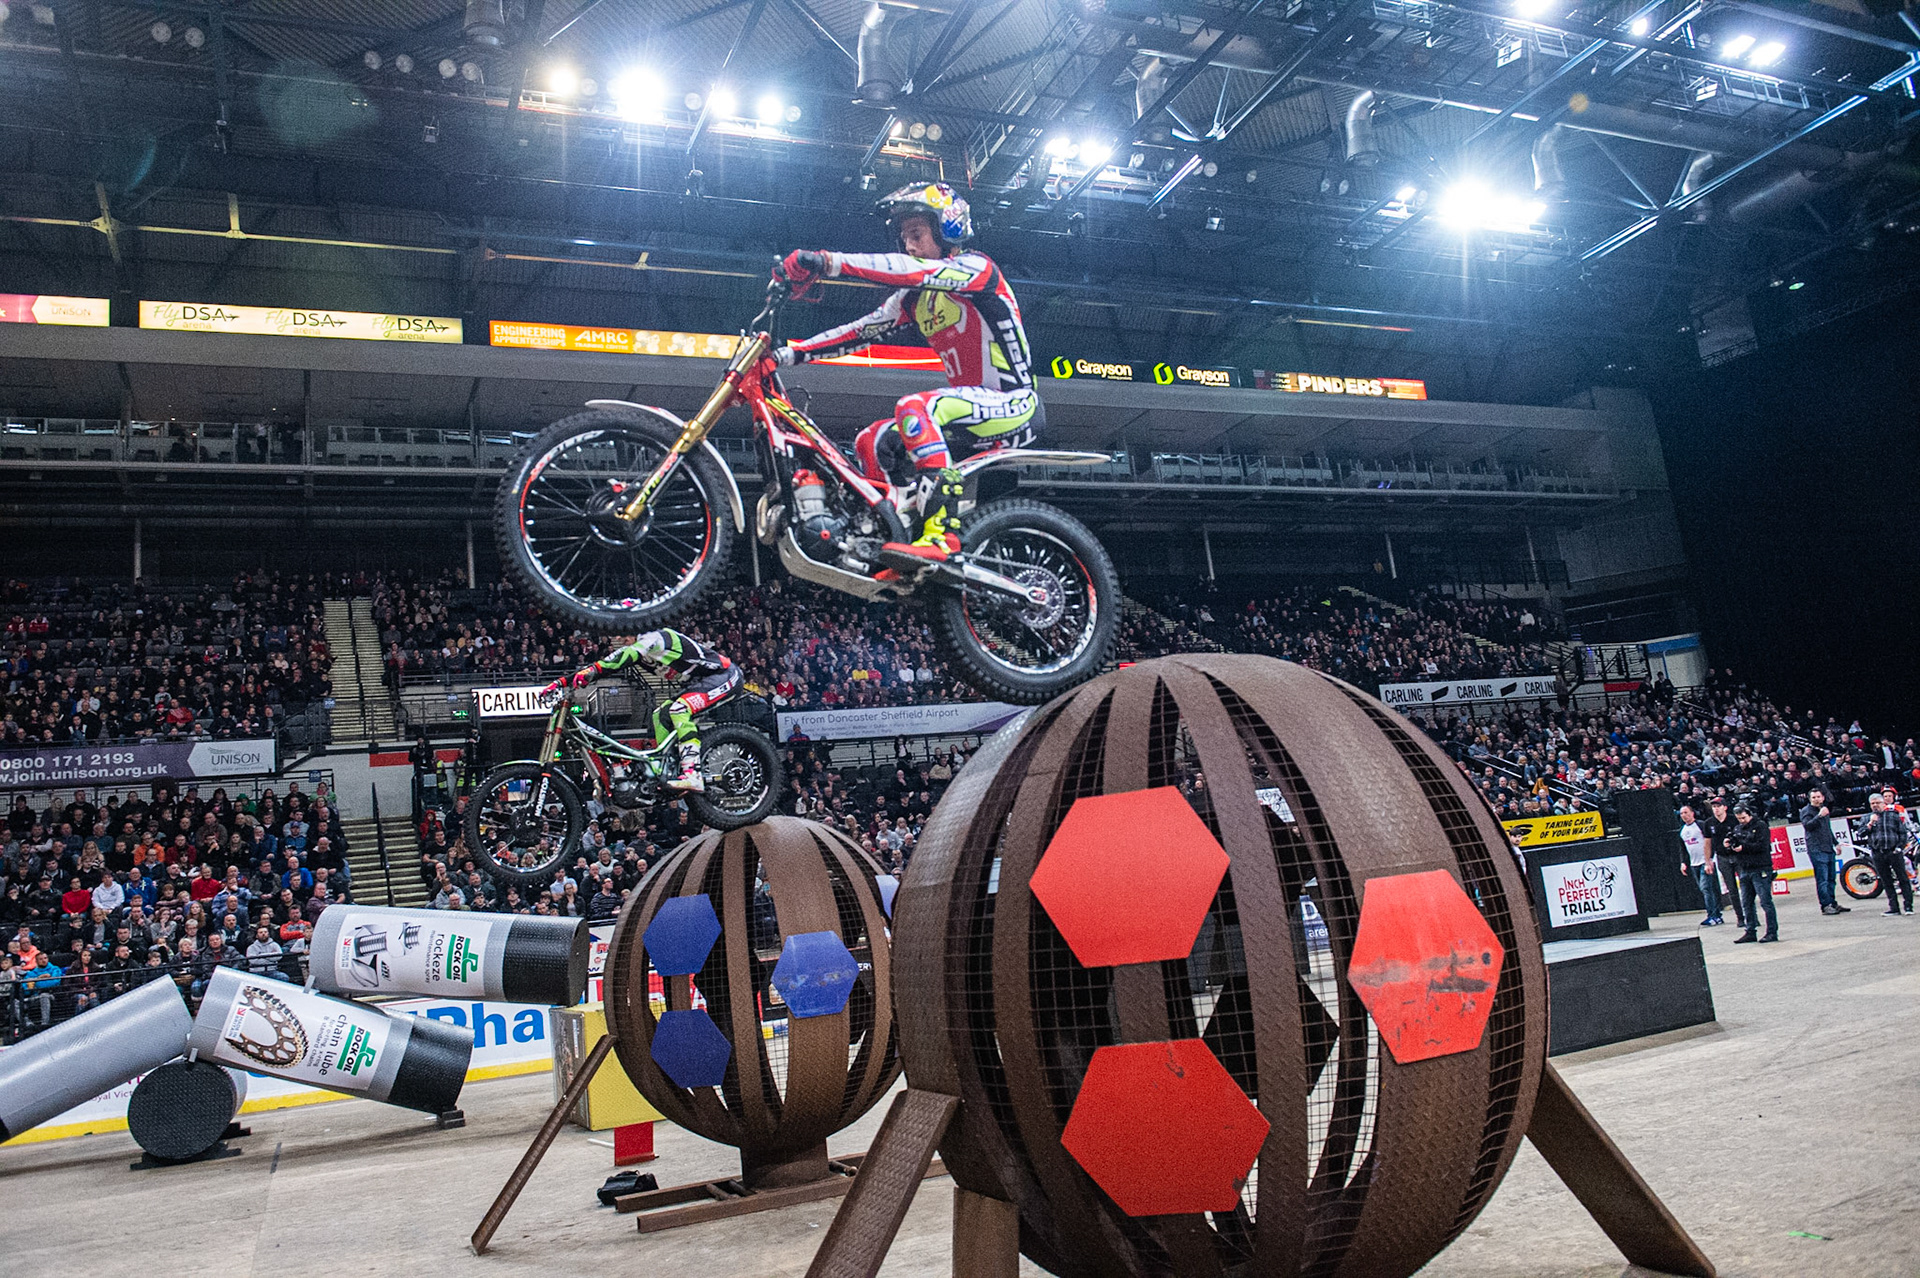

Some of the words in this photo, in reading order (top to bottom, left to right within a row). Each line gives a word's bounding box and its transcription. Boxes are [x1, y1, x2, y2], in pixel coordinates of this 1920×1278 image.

[51, 307, 91, 317] UNISON
[153, 304, 183, 326] Fly
[182, 305, 228, 321] DSA
[182, 320, 213, 329] arena
[264, 310, 294, 332] Fly
[293, 312, 335, 327] DSA
[372, 315, 399, 338] Fly
[397, 317, 439, 332] DSA
[293, 327, 321, 335] arena
[398, 332, 426, 341] arena
[493, 325, 566, 339] ENGINEERING
[574, 330, 629, 345] AMRC
[493, 335, 567, 347] APPRENTICESHIPS
[997, 318, 1033, 389] heb
[1075, 358, 1133, 378] Grayson
[1176, 365, 1230, 385] Grayson
[1297, 374, 1384, 396] PINDERS
[972, 398, 1032, 420] hebo
[1384, 688, 1424, 703] CARLING
[1456, 684, 1494, 699] CARLING
[1524, 681, 1556, 695] CARLIN
[784, 716, 800, 727] Fly
[801, 715, 826, 725] from
[828, 713, 878, 724] Doncaster
[881, 709, 923, 721] Sheffield
[926, 708, 959, 719] Airport
[0, 756, 45, 770] 0800
[52, 754, 83, 767] 171
[90, 752, 135, 765] 2193
[211, 753, 261, 766] UNISON
[534, 777, 549, 817] NONSTOP
[1539, 831, 1549, 839] OF
[1551, 828, 1571, 838] YOUR
[1571, 824, 1598, 835] WASTE
[1545, 819, 1573, 830] TAKING
[1573, 816, 1594, 826] CARE
[1563, 876, 1586, 890] INCH
[1558, 887, 1600, 904] PERFECT
[1561, 899, 1606, 917] TRIALS
[432, 933, 446, 982] rockeze
[452, 935, 465, 965] ROCK
[452, 965, 462, 981] OIL
[329, 1014, 347, 1048] chain
[427, 1002, 546, 1049] Pha
[350, 1026, 366, 1058] ROCK
[318, 1052, 337, 1076] lube
[342, 1057, 355, 1073] OIL
[92, 1091, 111, 1103] oyal
[114, 1090, 132, 1099] Vict
